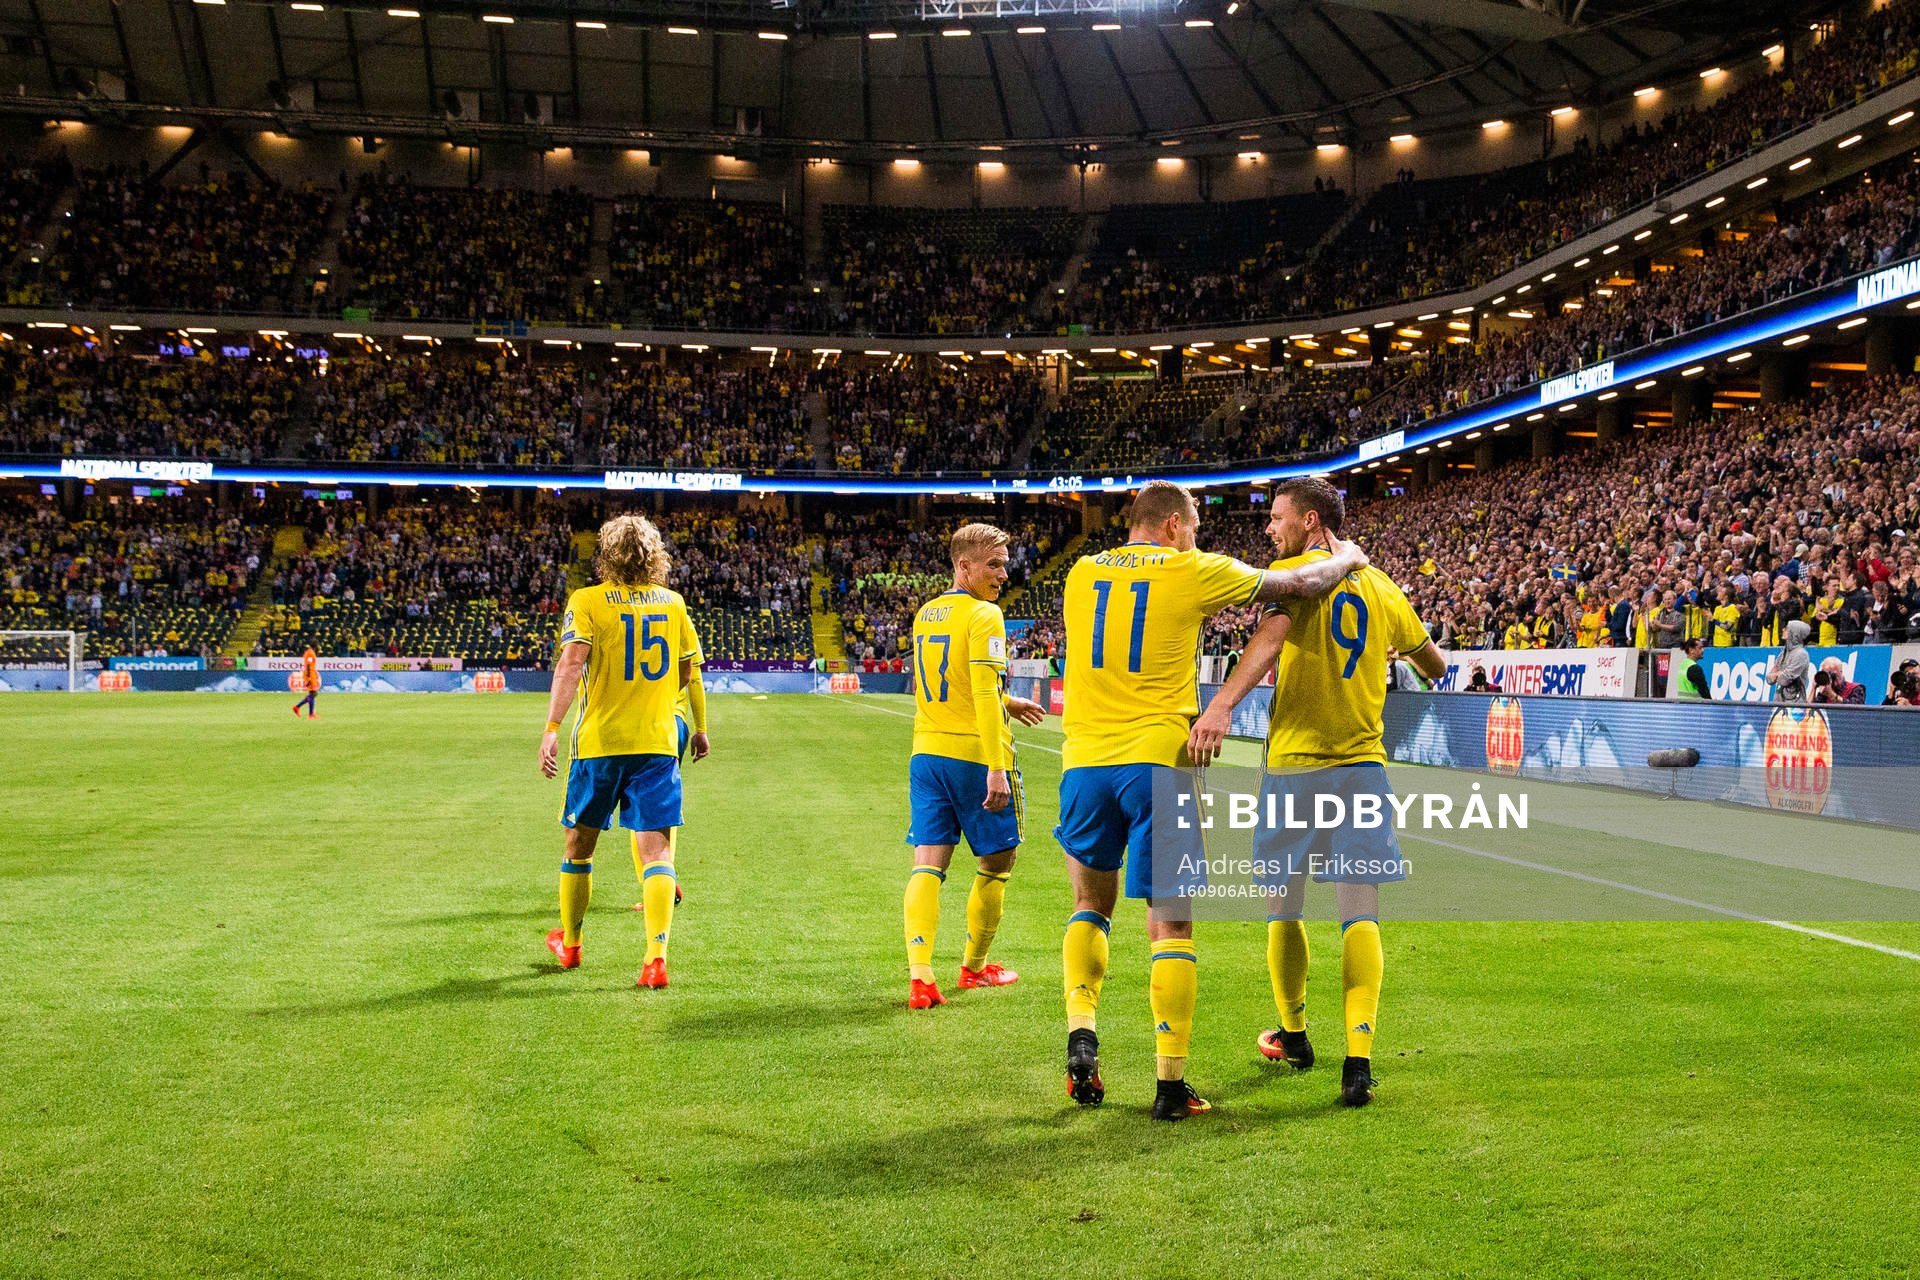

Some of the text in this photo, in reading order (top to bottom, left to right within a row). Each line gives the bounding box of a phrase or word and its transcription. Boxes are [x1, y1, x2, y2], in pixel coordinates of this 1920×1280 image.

[61, 459, 213, 480] NATIONALSPORTEN
[604, 471, 742, 490] NATIONALSPORTEN
[1049, 476, 1083, 489] 43:05
[605, 589, 673, 604] HILJEMARK
[921, 606, 953, 622] WENDT
[1092, 580, 1150, 672] 11
[620, 613, 670, 681] 15
[1331, 591, 1368, 679] 9
[917, 635, 950, 702] 17
[1504, 664, 1586, 696] INTERSPORT
[1488, 731, 1521, 760] GULD
[1768, 734, 1828, 752] NORRLANDS
[1766, 753, 1829, 794] GULD
